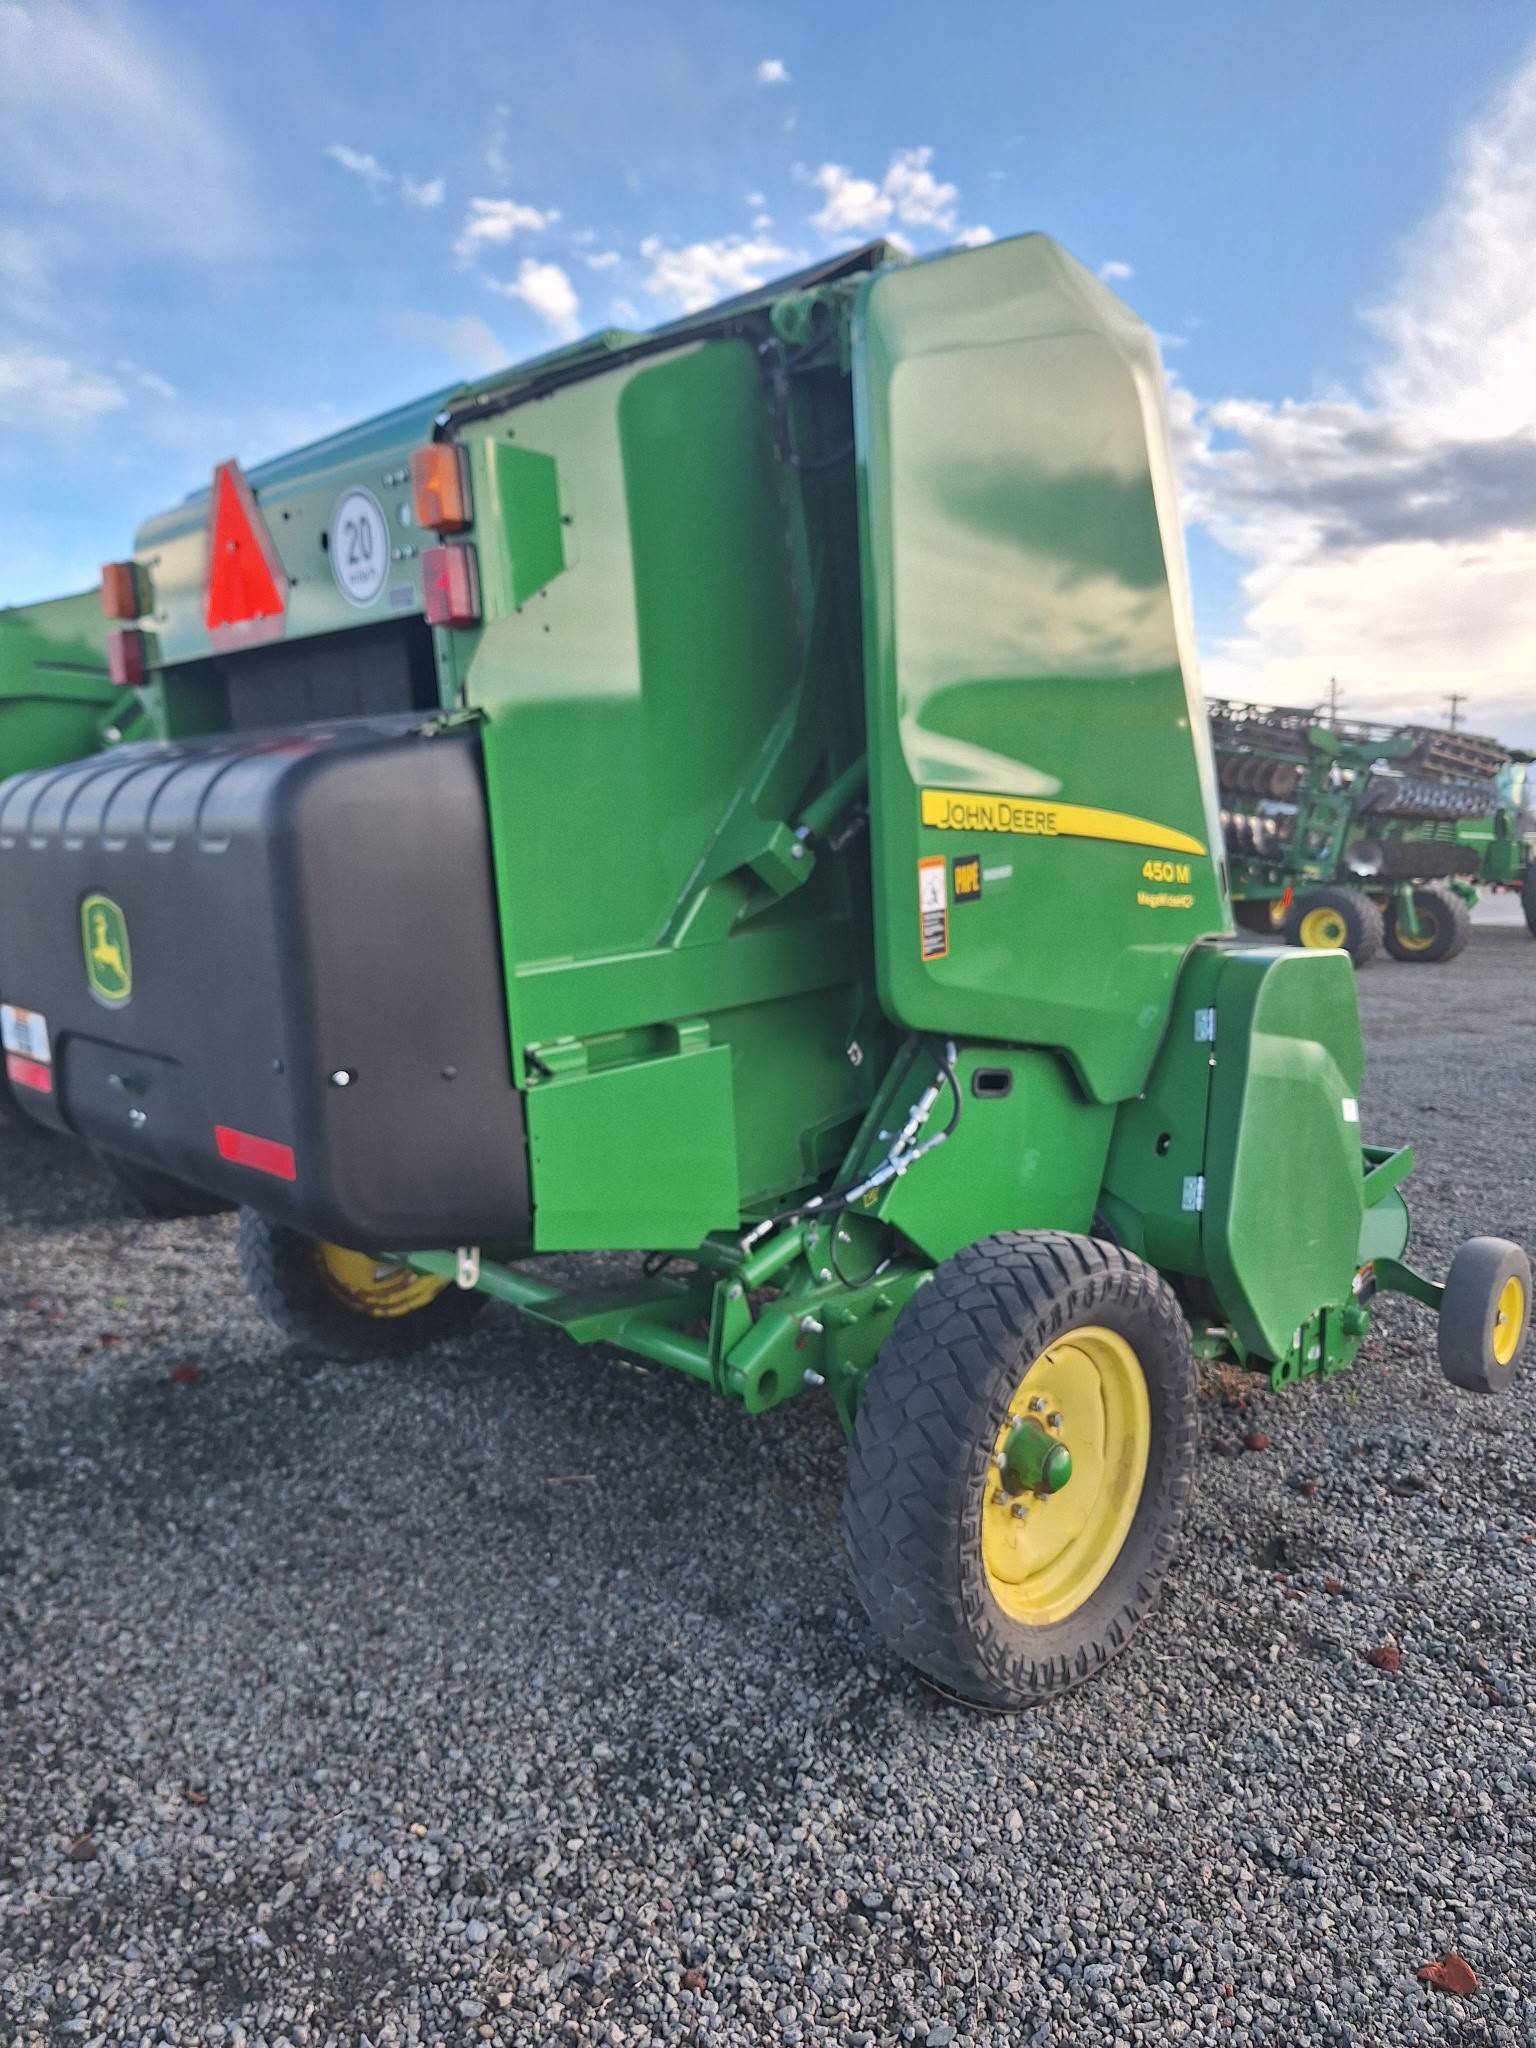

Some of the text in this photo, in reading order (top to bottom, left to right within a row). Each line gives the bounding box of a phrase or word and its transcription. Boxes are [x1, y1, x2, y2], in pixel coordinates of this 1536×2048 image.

[344, 516, 373, 565] 20
[939, 799, 1057, 831] JOHN DEERE
[1142, 860, 1191, 884] 450 M
